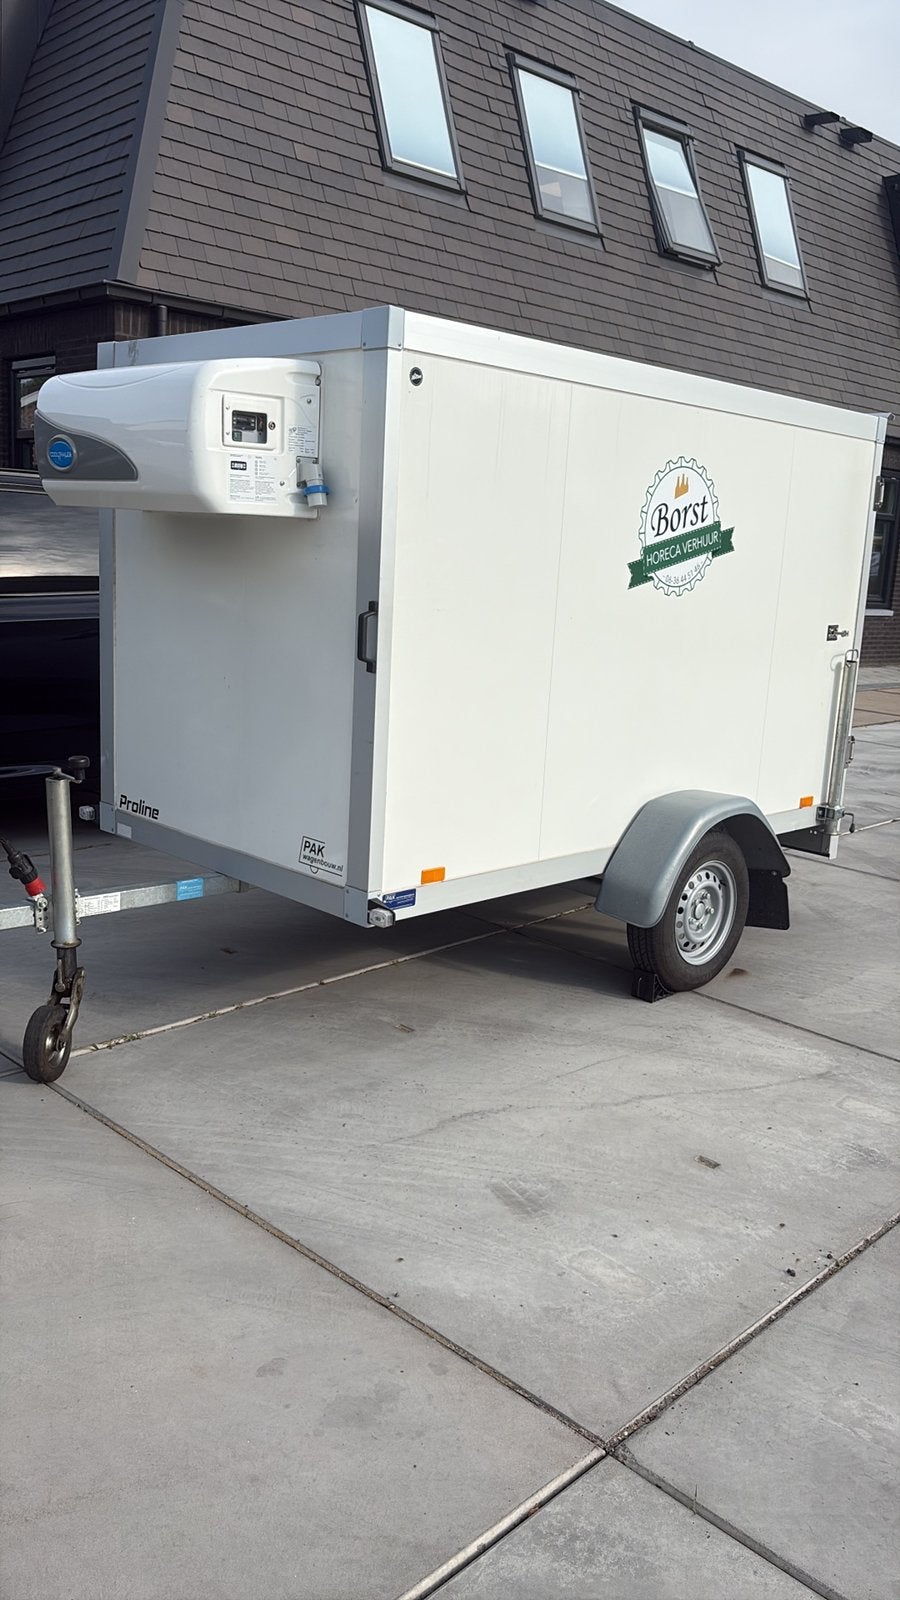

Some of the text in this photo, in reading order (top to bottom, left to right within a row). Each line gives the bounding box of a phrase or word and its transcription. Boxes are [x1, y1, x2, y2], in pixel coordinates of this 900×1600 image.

[650, 495, 709, 538] Borst
[646, 530, 719, 567] HORECA VERHUUR
[119, 794, 160, 820] Proline
[303, 840, 325, 858] PAK
[303, 854, 344, 872] wagenbouw.nl
